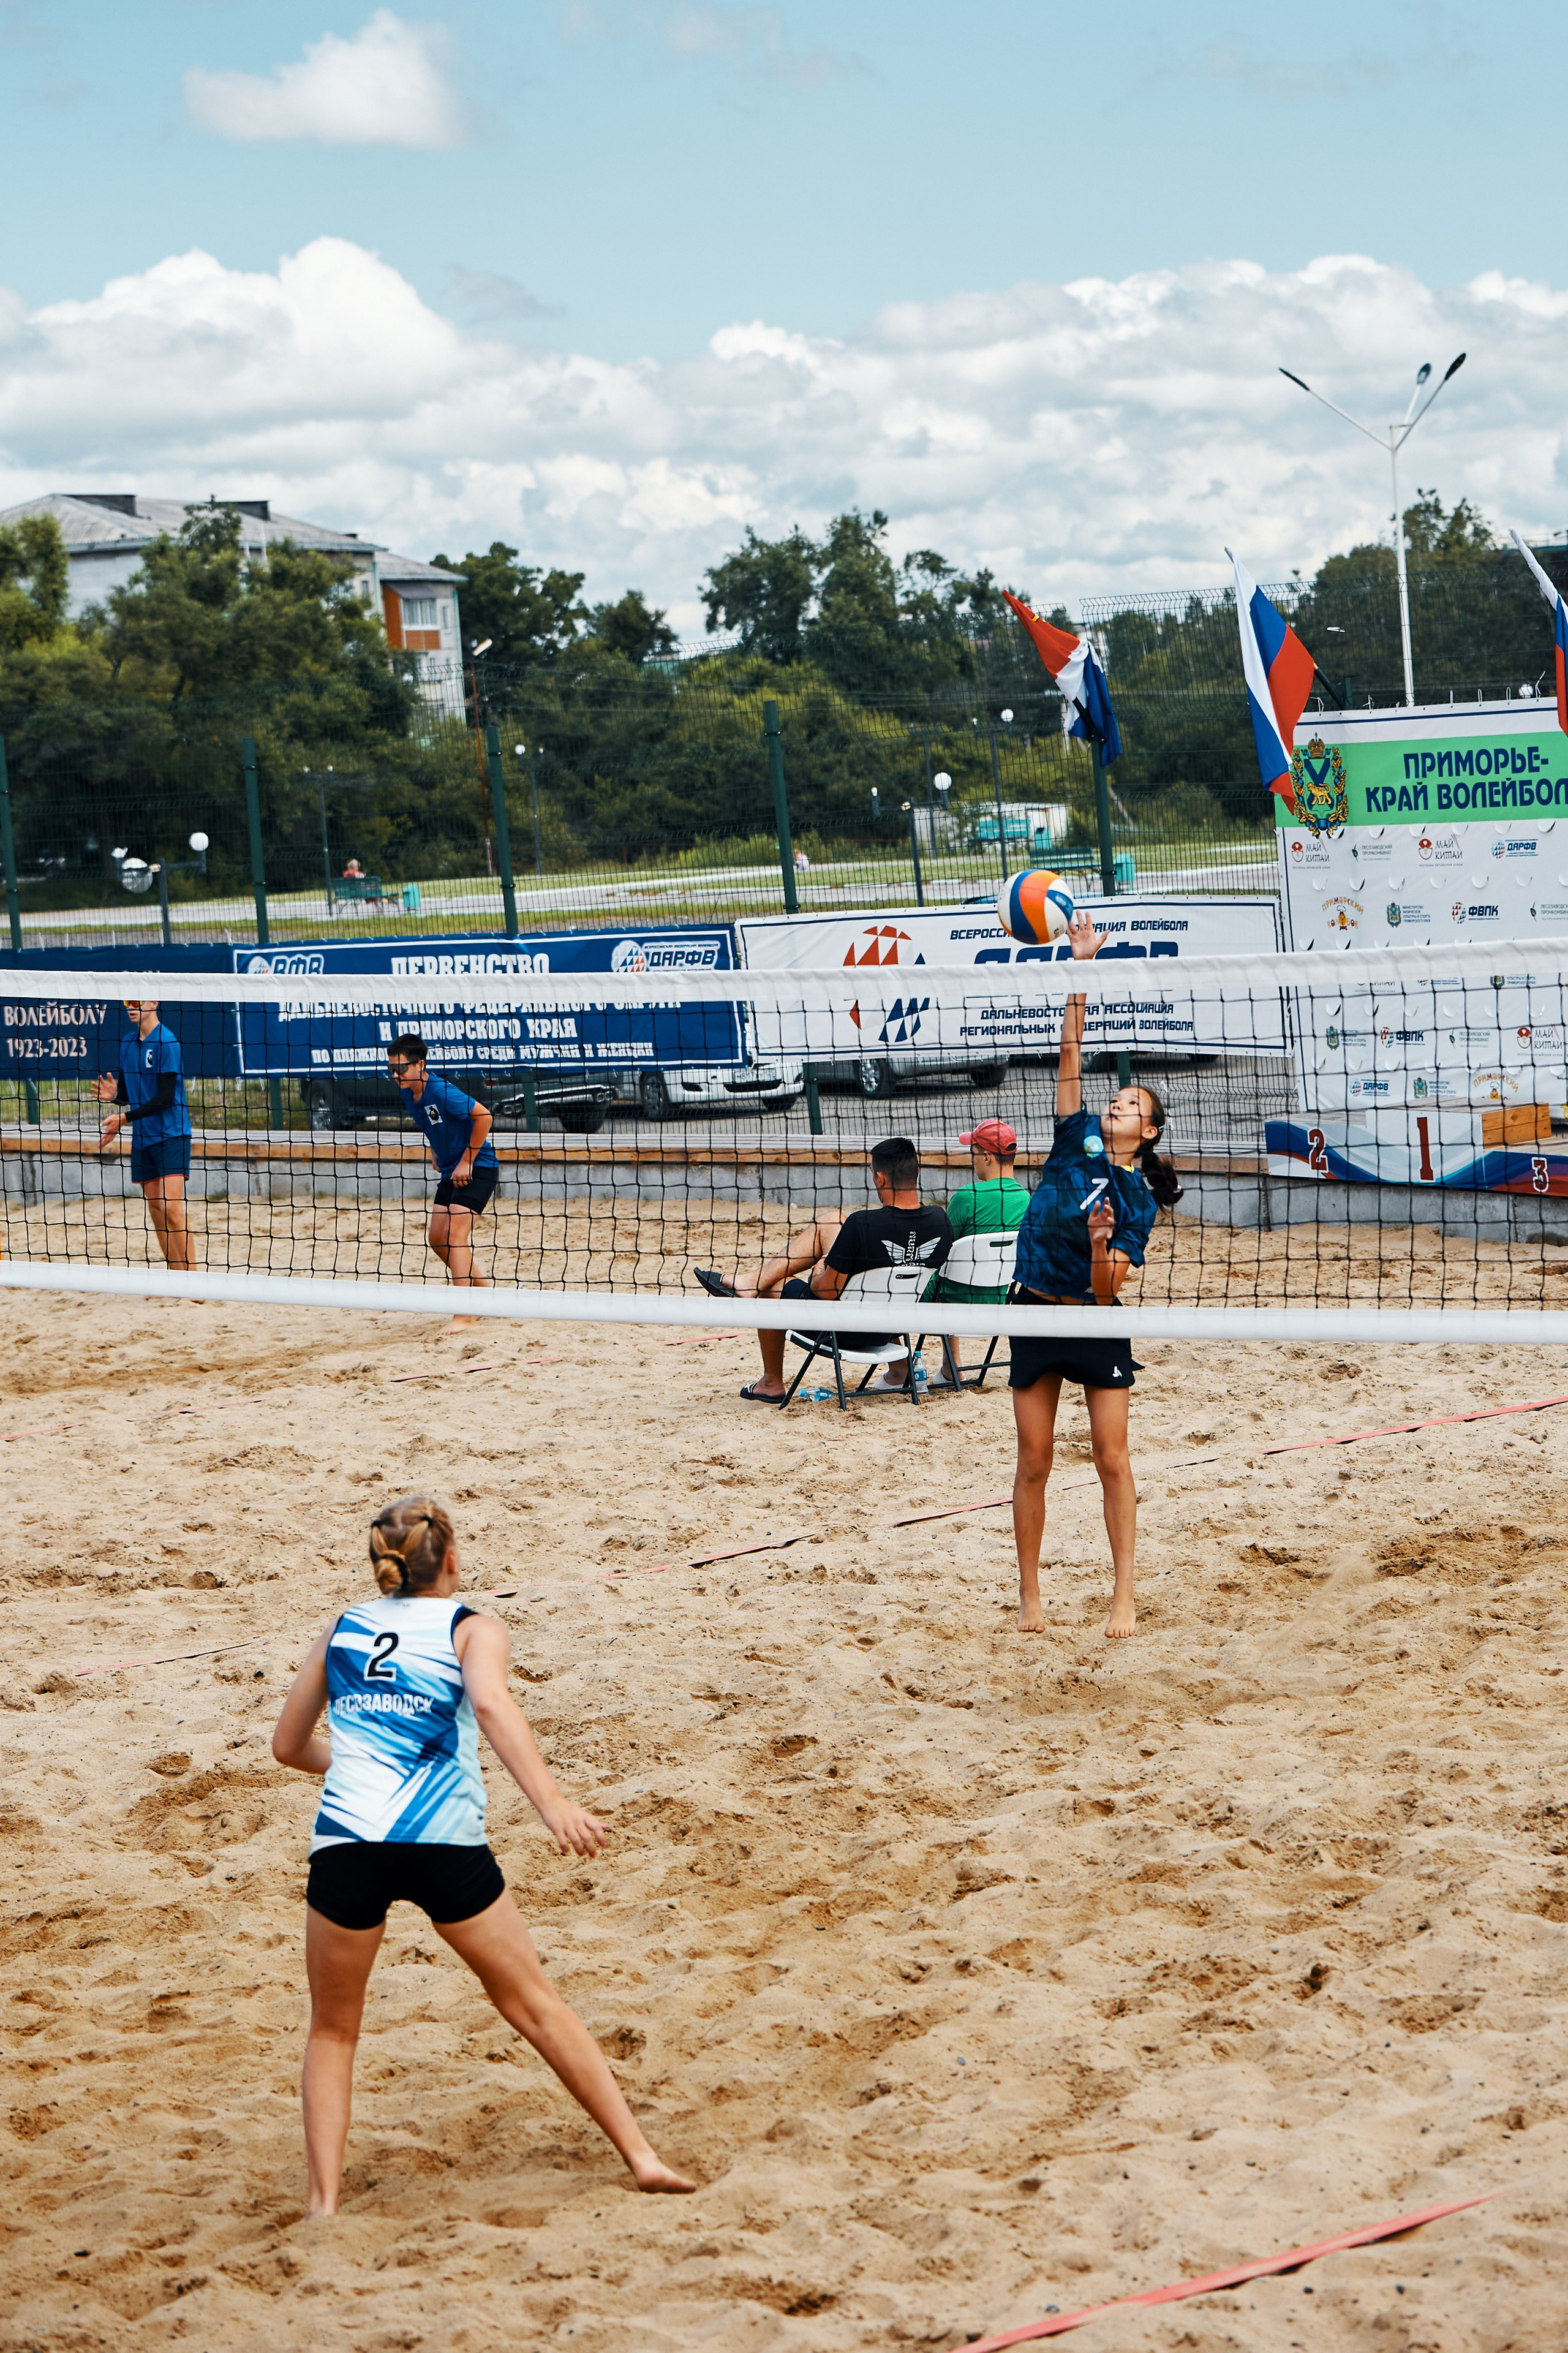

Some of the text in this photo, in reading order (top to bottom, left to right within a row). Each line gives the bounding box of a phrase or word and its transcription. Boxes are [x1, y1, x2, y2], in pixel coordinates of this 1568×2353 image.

[1403, 746, 1548, 779] ПРИМОРЬЕ-
[1365, 782, 1428, 812] КРАЙ
[1507, 842, 1537, 852] ДАРФВ
[1468, 905, 1499, 916] ФВПК
[950, 927, 1011, 940] ВСЕРОССИ
[1131, 918, 1188, 931] ВОЛЕЙБОЛА
[649, 950, 715, 967] ДАРФВ
[4, 1001, 107, 1026] ВОЛЕЙБОЛУ
[981, 1003, 1174, 1020] ДАЛЬНЕВОСТОАЯ АССОЦИАЦИЯ
[379, 1018, 578, 1041] И ПРИМОРСКОГО КРАЯ
[960, 1024, 1055, 1036] РЕГИОНАЛЬНЫХ
[1139, 1018, 1193, 1032] ВОЛЕЙБОЛА
[1396, 1030, 1424, 1042] ФВПК
[7, 1037, 88, 1058] 1923-2023
[312, 1049, 330, 1063] ПО
[332, 1047, 389, 1063] ПЛЯЖНО
[477, 1045, 516, 1062] СРЕДИ
[519, 1044, 581, 1060] МУЖЧИН
[583, 1044, 594, 1058] И
[596, 1042, 654, 1059] ЖЕНЩИН
[1308, 1128, 1328, 1172] 2
[1416, 1116, 1434, 1181] 1
[1532, 1158, 1549, 1192] 3
[1079, 1177, 1109, 1210] 7
[366, 1631, 399, 1680] 2
[333, 1693, 434, 1716] ЛЕСОЗАВОДСК
